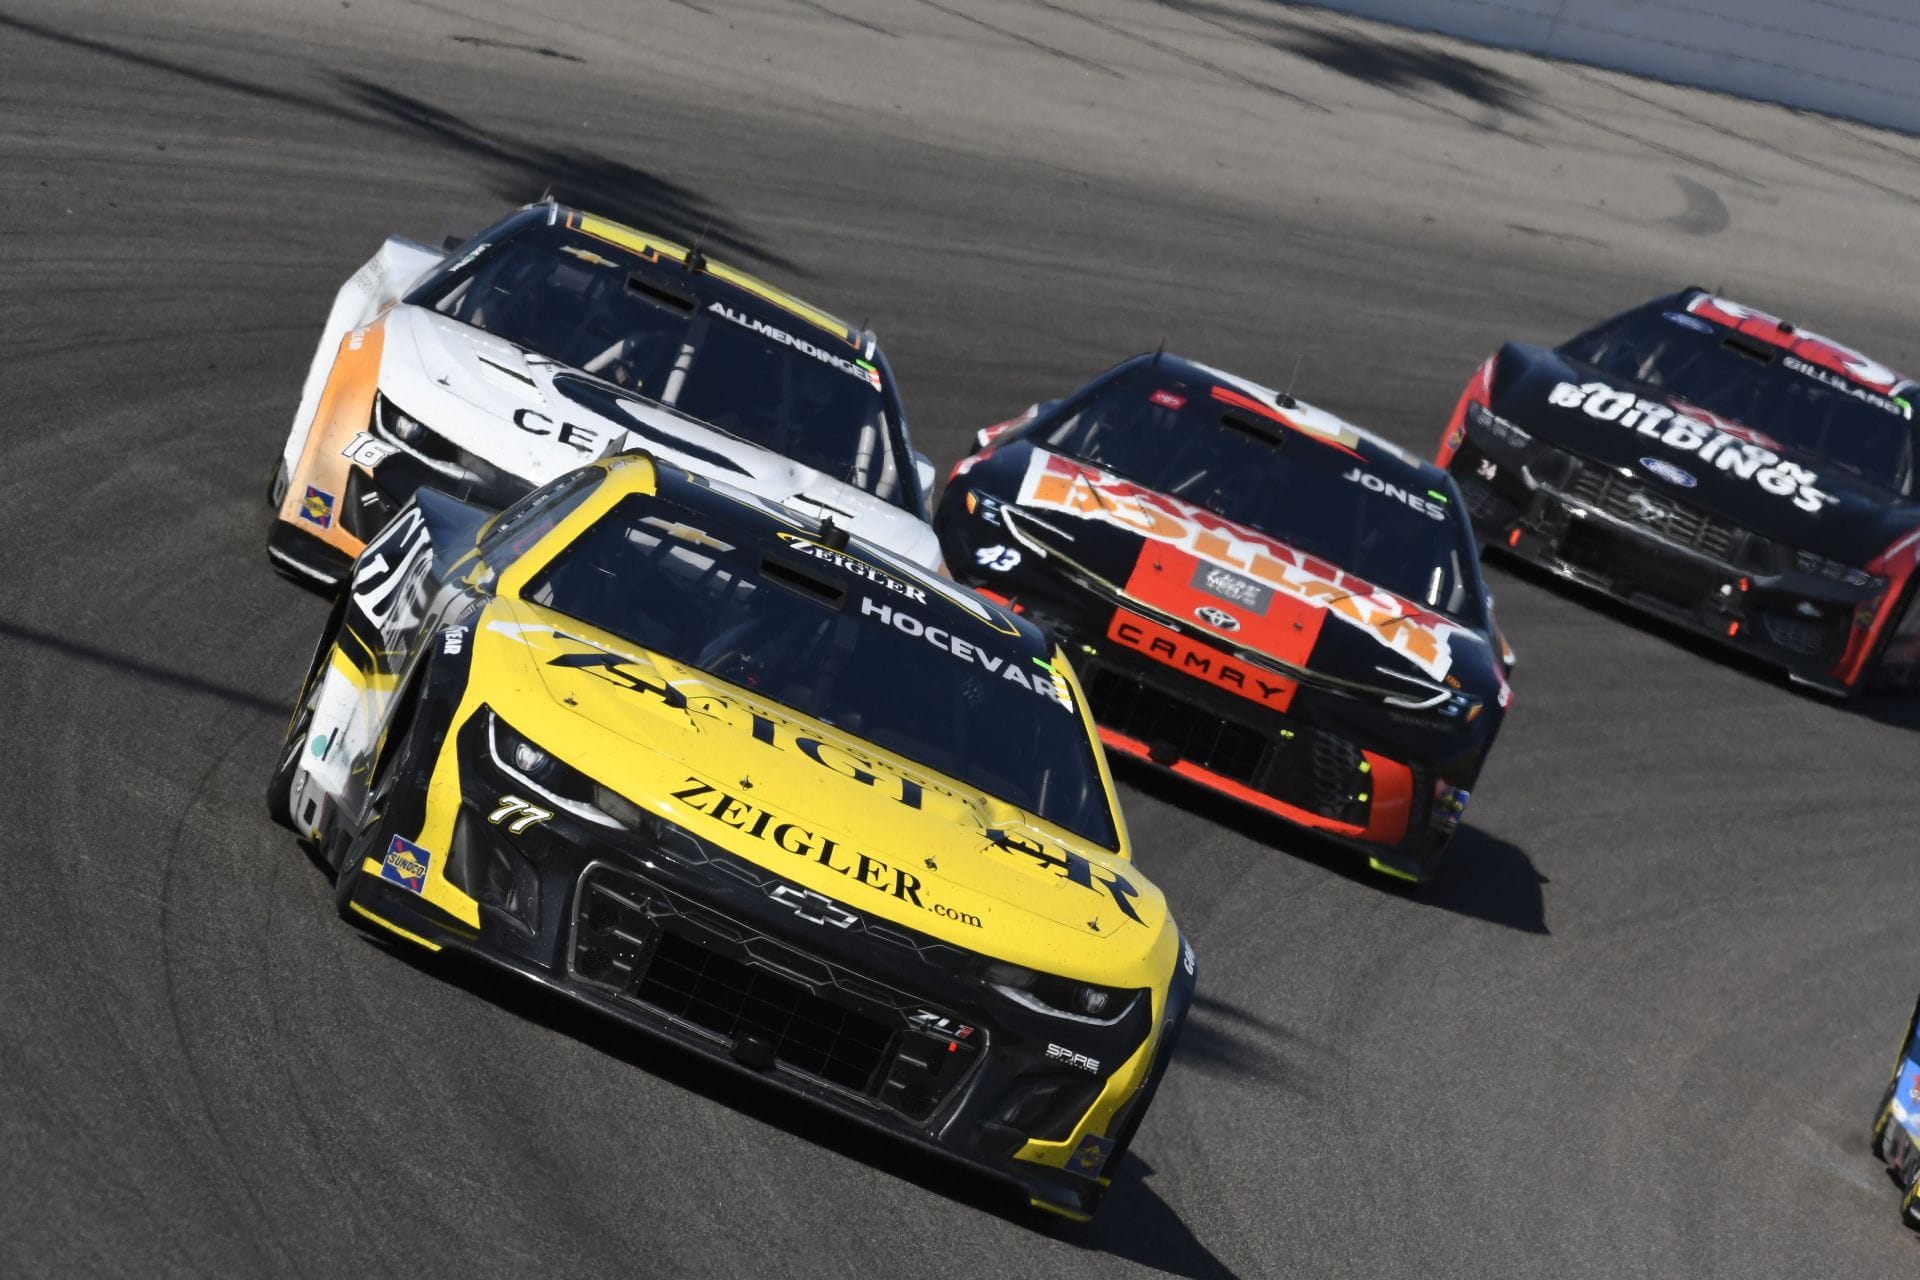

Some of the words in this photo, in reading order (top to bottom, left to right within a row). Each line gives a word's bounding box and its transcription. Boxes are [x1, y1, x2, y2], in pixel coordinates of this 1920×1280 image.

[341, 432, 400, 467] 16
[1548, 382, 1839, 512] BUILDINGS
[1476, 458, 1498, 481] 34
[1342, 468, 1445, 520] JONES
[789, 539, 927, 606] ZEIGLER
[976, 544, 1021, 572] 43
[861, 597, 1066, 704] HOCEVAR
[1117, 623, 1285, 699] CAMRY
[488, 795, 555, 835] 77
[387, 851, 427, 878] SUNOCO
[670, 776, 983, 929] ZEIGLER.com
[908, 1009, 975, 1039] ZL1
[1046, 1043, 1100, 1071] SPIRE
